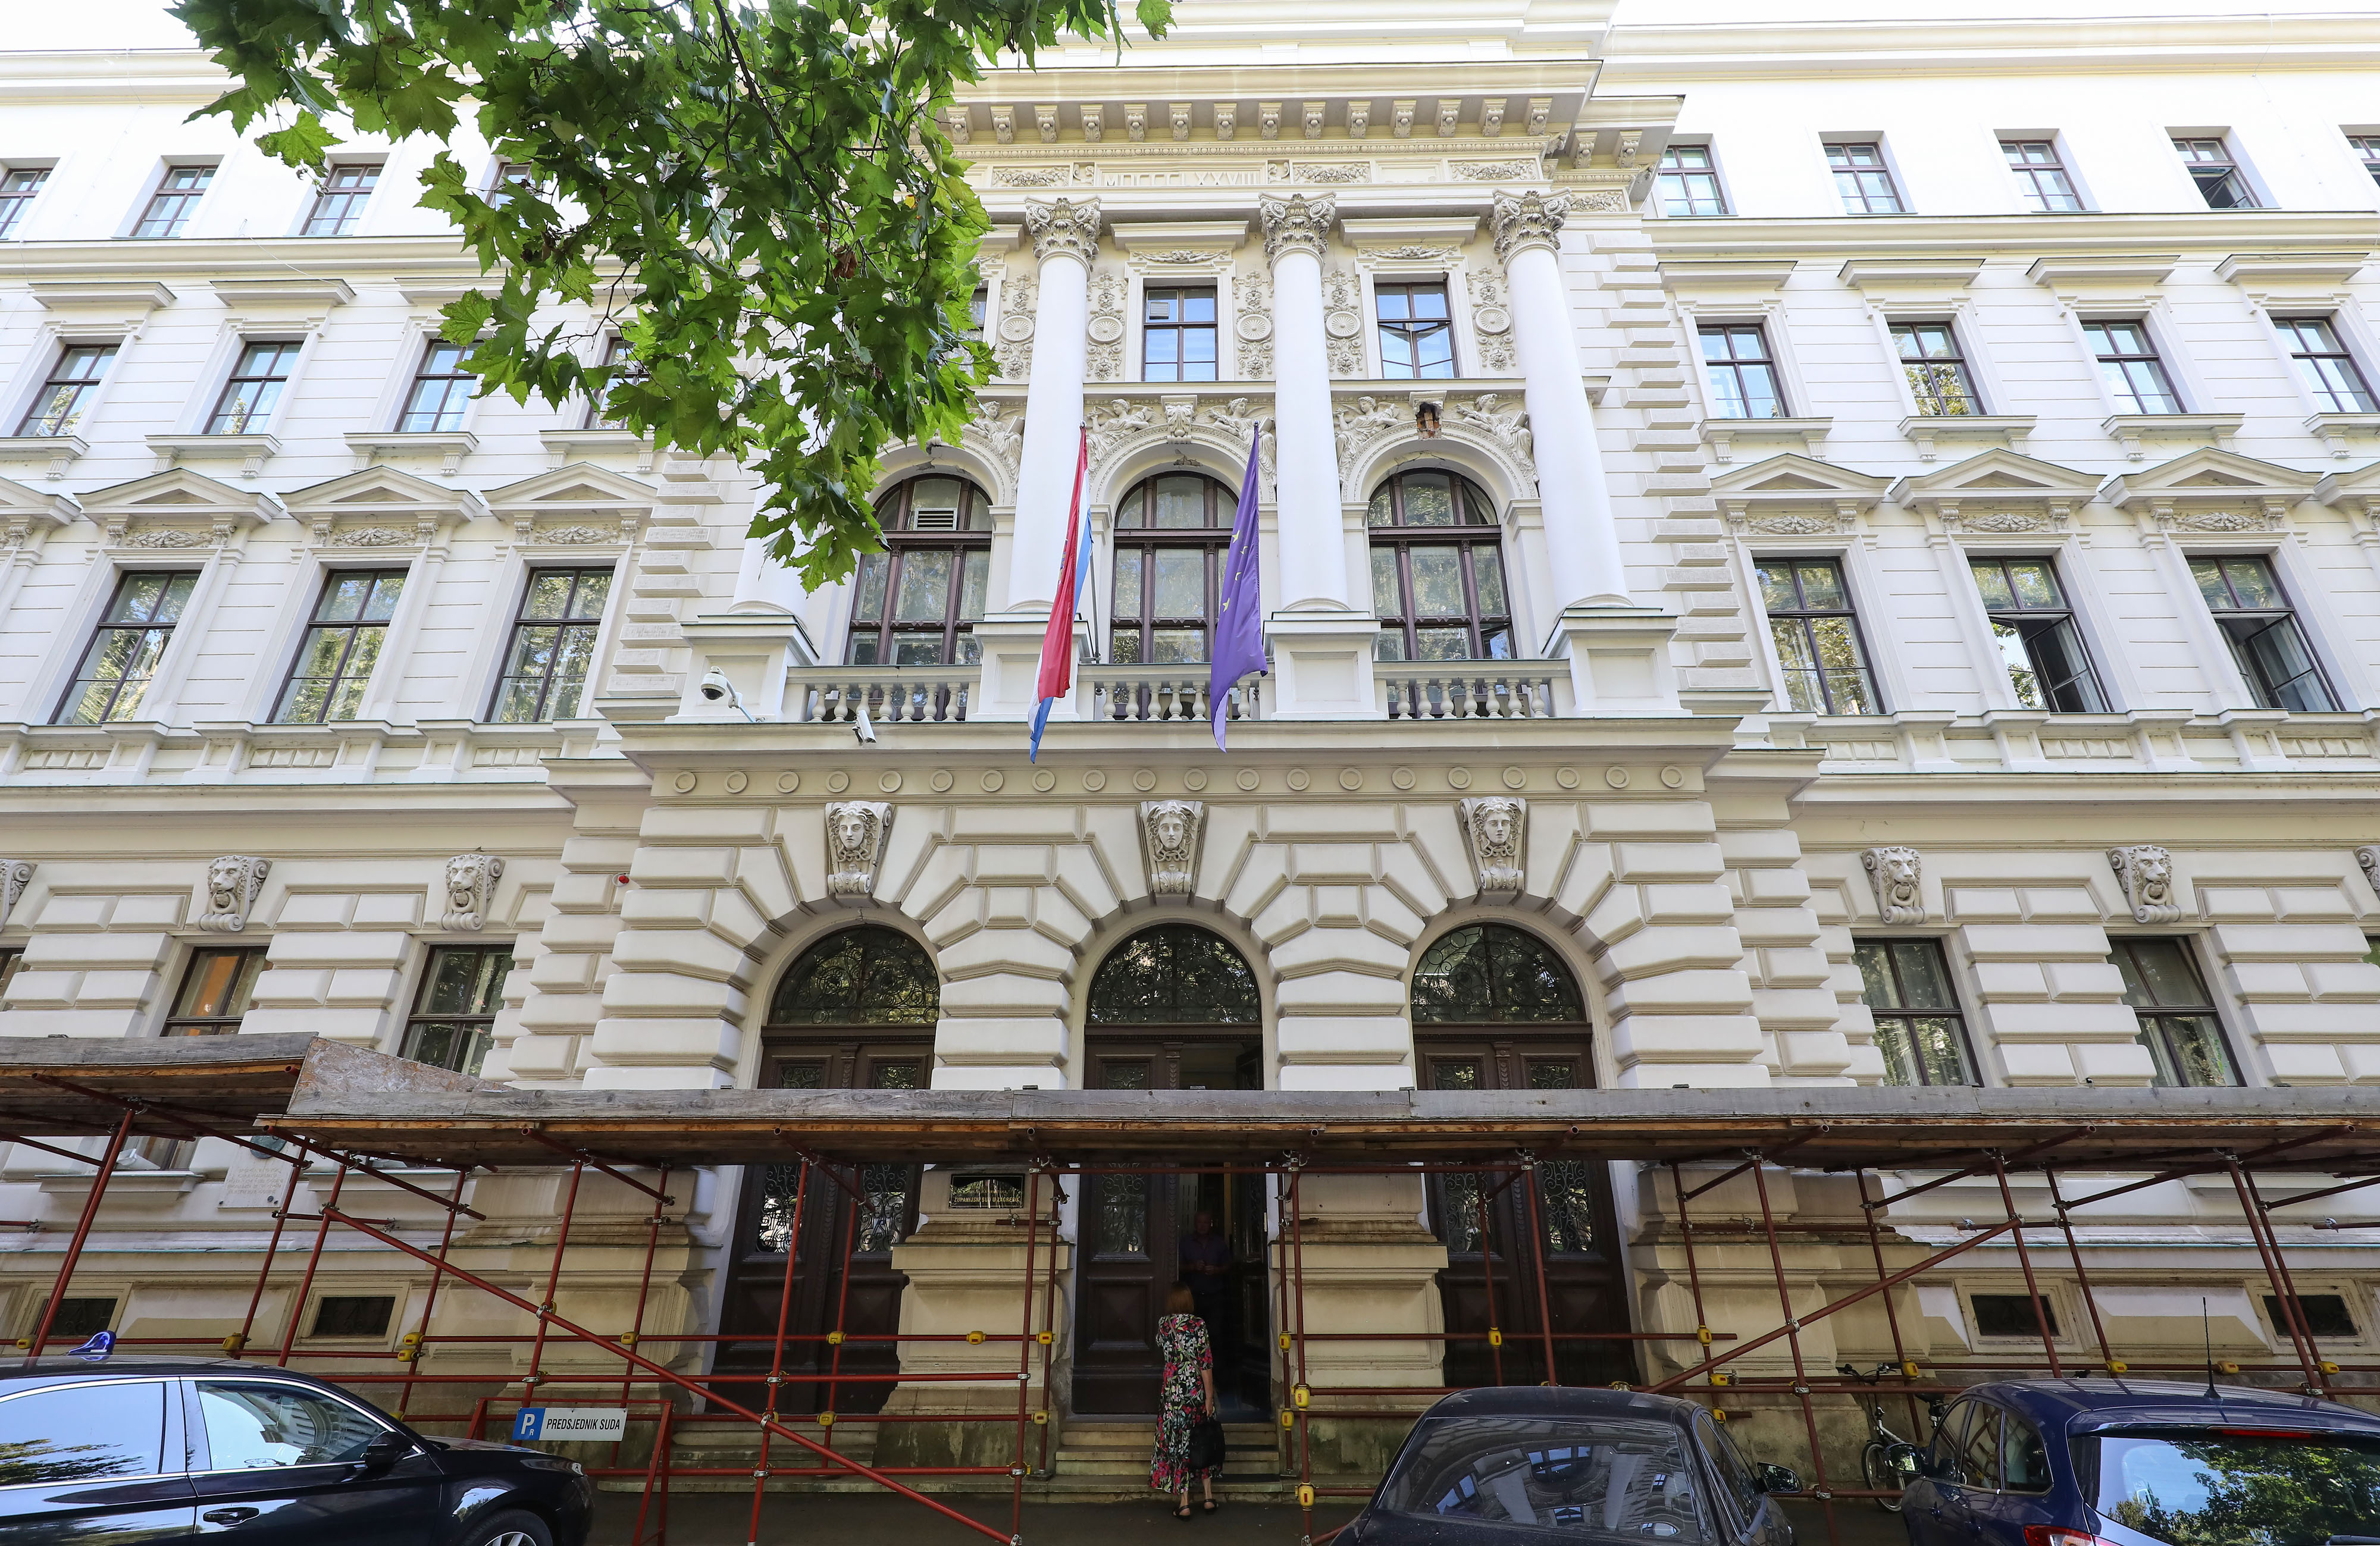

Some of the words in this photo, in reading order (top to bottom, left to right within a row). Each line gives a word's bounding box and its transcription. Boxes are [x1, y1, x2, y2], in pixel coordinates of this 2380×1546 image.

[521, 1413, 536, 1435] P
[546, 1419, 599, 1430] PREDSJEDNIK
[599, 1419, 620, 1430] SUDA
